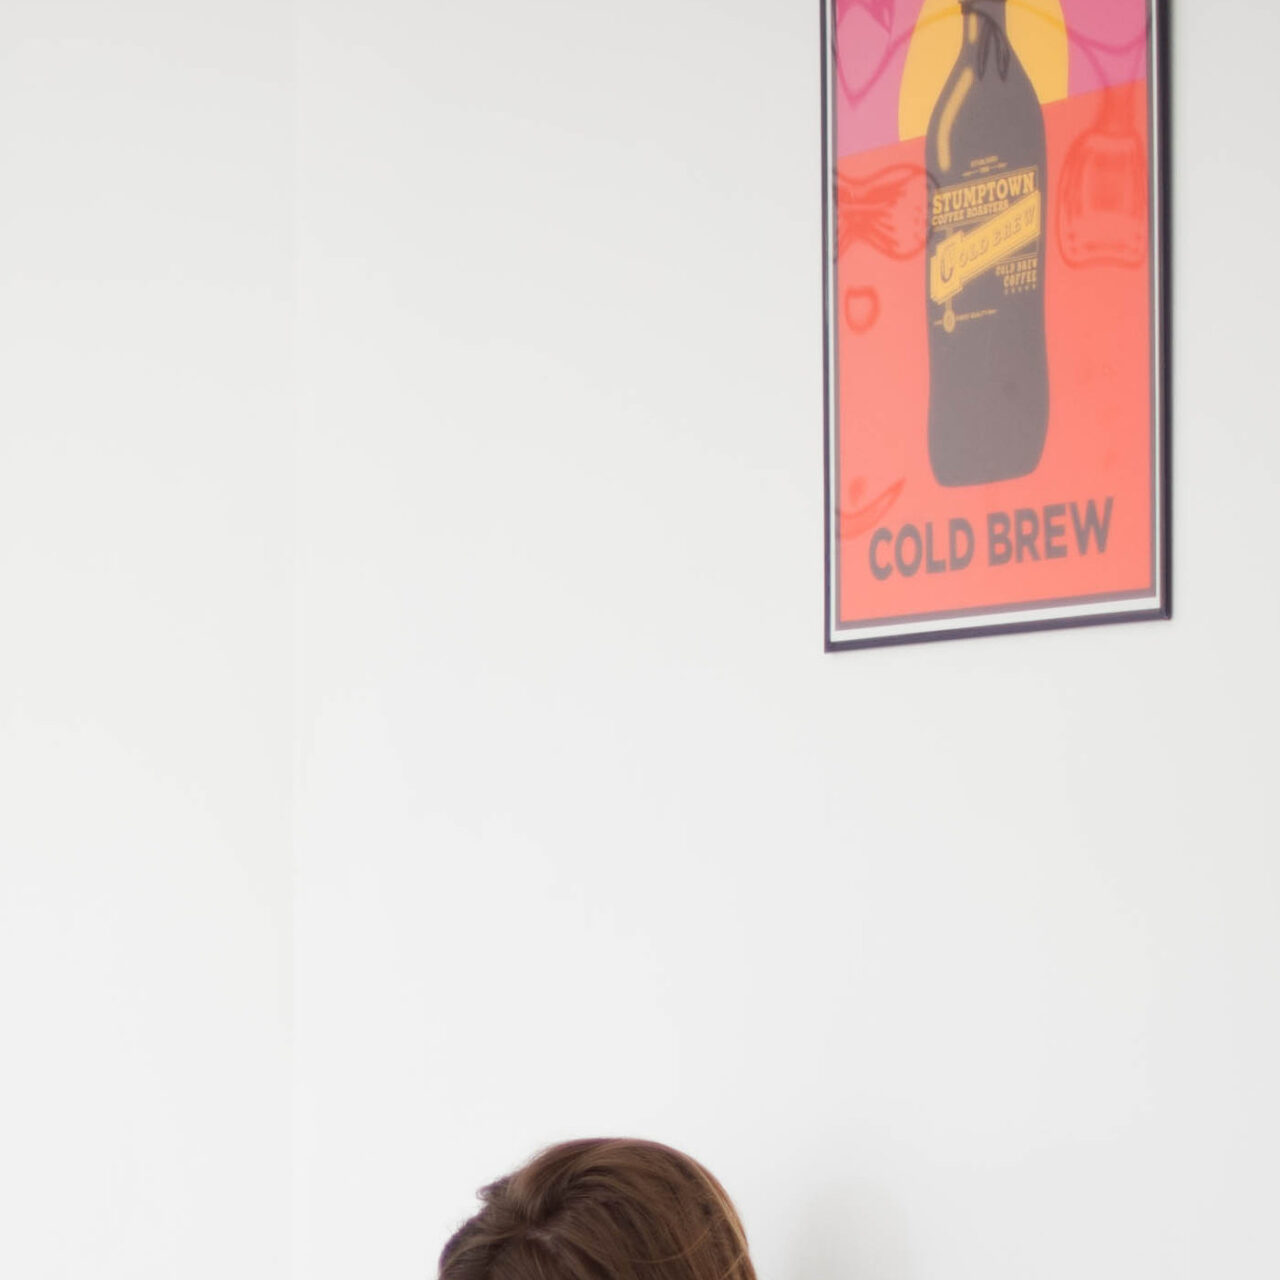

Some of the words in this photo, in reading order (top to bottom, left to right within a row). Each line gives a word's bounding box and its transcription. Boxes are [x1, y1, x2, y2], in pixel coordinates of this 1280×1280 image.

[932, 172, 1035, 215] STUMPTOWN
[932, 209, 964, 226] COFFEE
[869, 517, 975, 581] COLD
[986, 496, 1114, 567] BREW
